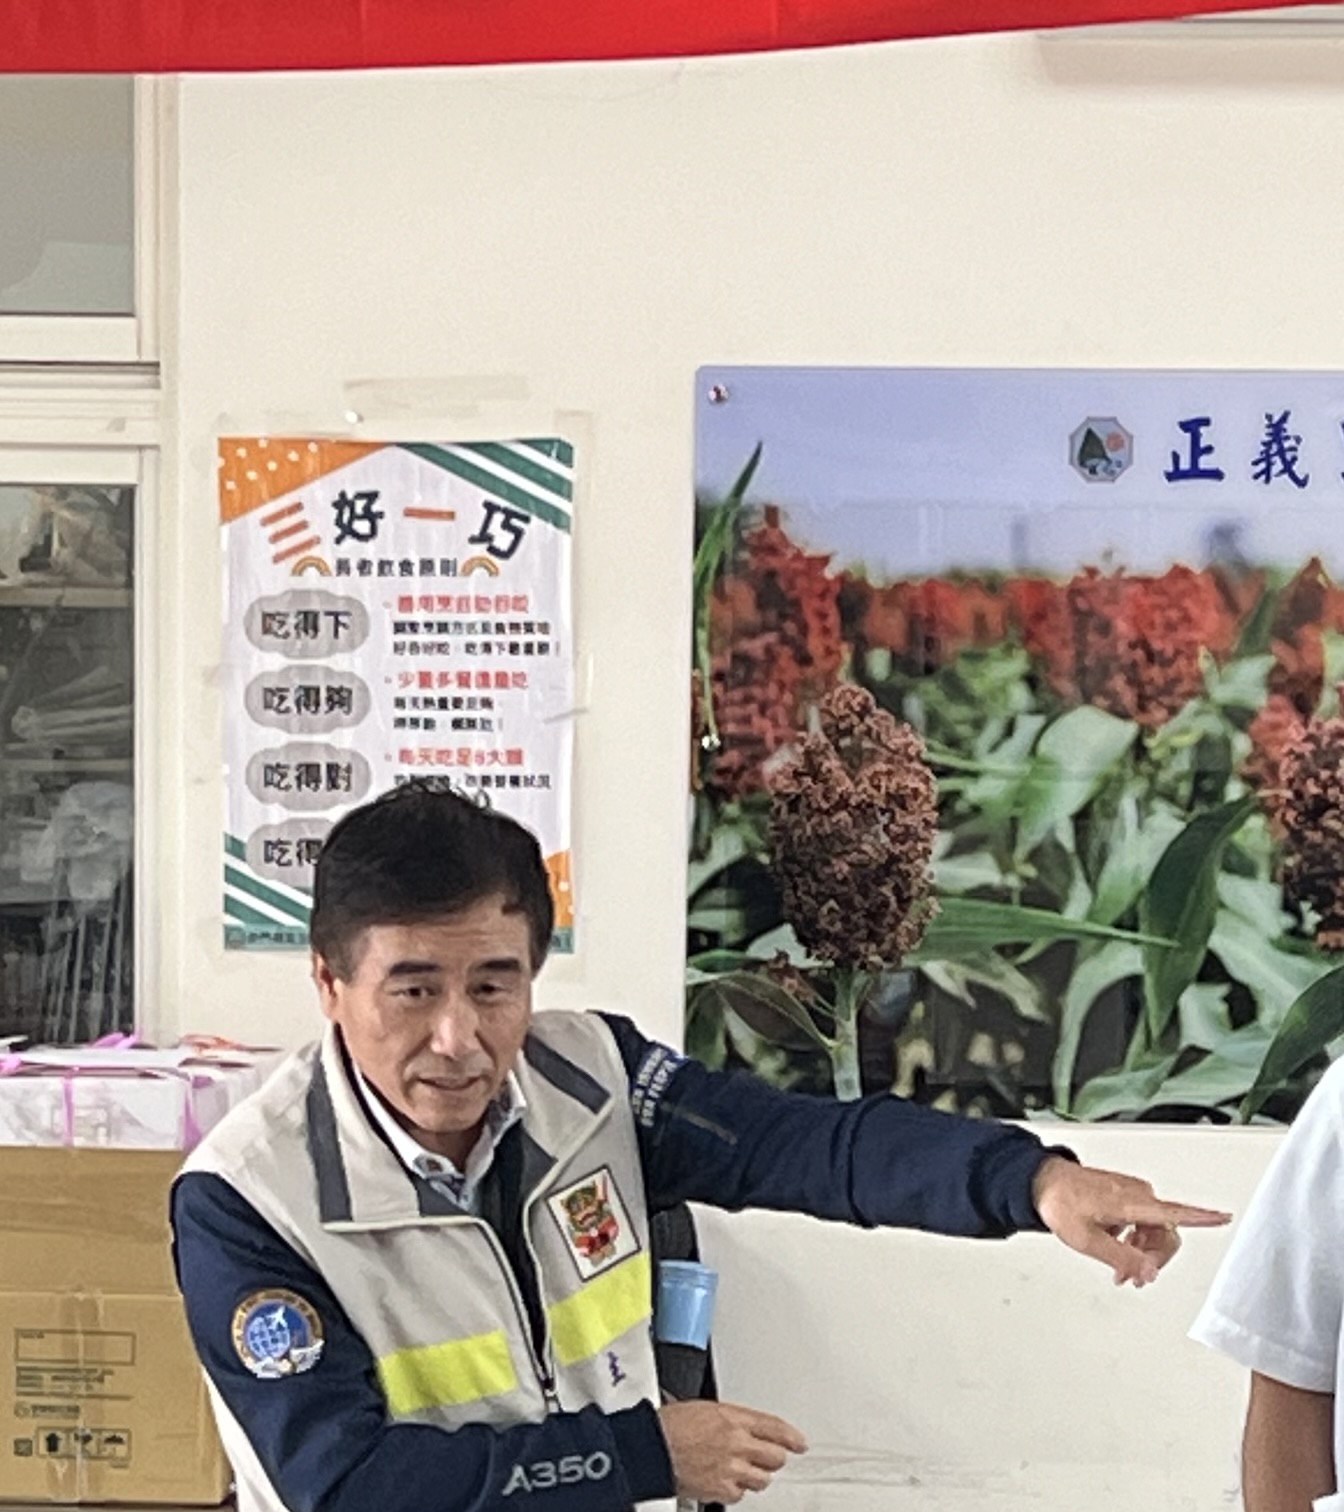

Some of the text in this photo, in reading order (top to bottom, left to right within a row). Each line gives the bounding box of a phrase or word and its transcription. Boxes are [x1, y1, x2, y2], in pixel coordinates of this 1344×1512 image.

[259, 489, 532, 563] 三好一巧
[261, 610, 353, 640] 吃得下
[262, 685, 353, 715] 吃得夠
[263, 762, 353, 793] 吃得對
[501, 1451, 612, 1496] A350
